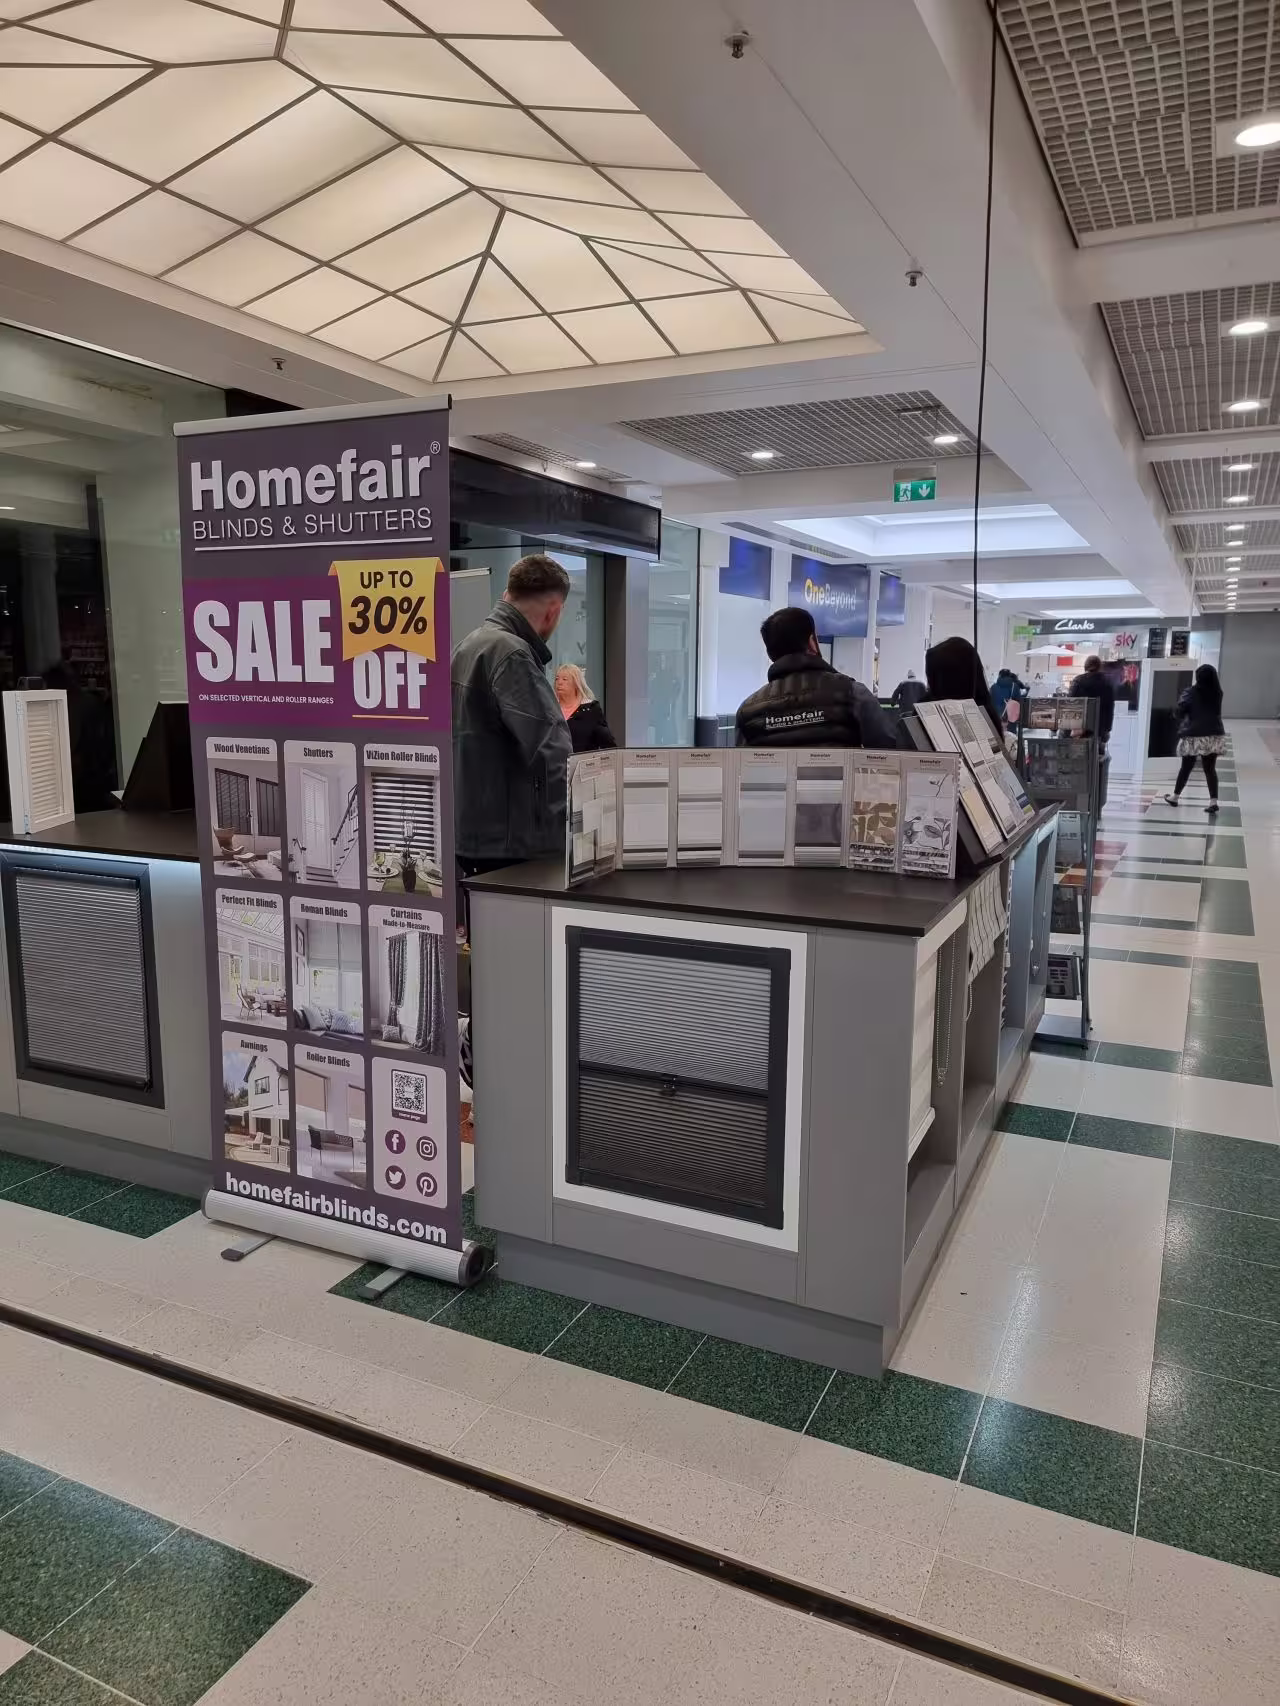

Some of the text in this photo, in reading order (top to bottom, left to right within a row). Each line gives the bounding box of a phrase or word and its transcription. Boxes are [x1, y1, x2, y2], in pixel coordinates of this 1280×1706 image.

[193, 507, 432, 540] BLINDS & SHUTTERS
[360, 570, 413, 589] UP TO
[348, 595, 428, 635] 30%
[1054, 619, 1095, 631] Clarks
[193, 600, 334, 683] SALE
[1115, 632, 1138, 650] sky
[352, 651, 428, 709] OFF
[210, 694, 240, 702] SELECTED
[241, 694, 270, 703] VERTICAL
[271, 695, 285, 703] AND
[286, 696, 307, 704] ROLLER
[308, 696, 334, 704] RANGES
[766, 710, 824, 724] Homefair
[214, 743, 270, 755] Wood Venetians
[303, 747, 334, 758] Shutters
[366, 750, 438, 763] ViZion Roller Blinds
[221, 894, 277, 909] Perfect Fit Blinds
[301, 903, 348, 918] Roman Blinds
[390, 908, 422, 921] Curtains
[382, 918, 430, 931] Made-to-Measure
[240, 1039, 268, 1053] Awnings
[306, 1051, 350, 1068] Roller Blinds
[225, 1172, 447, 1244] homefairblinds.com
